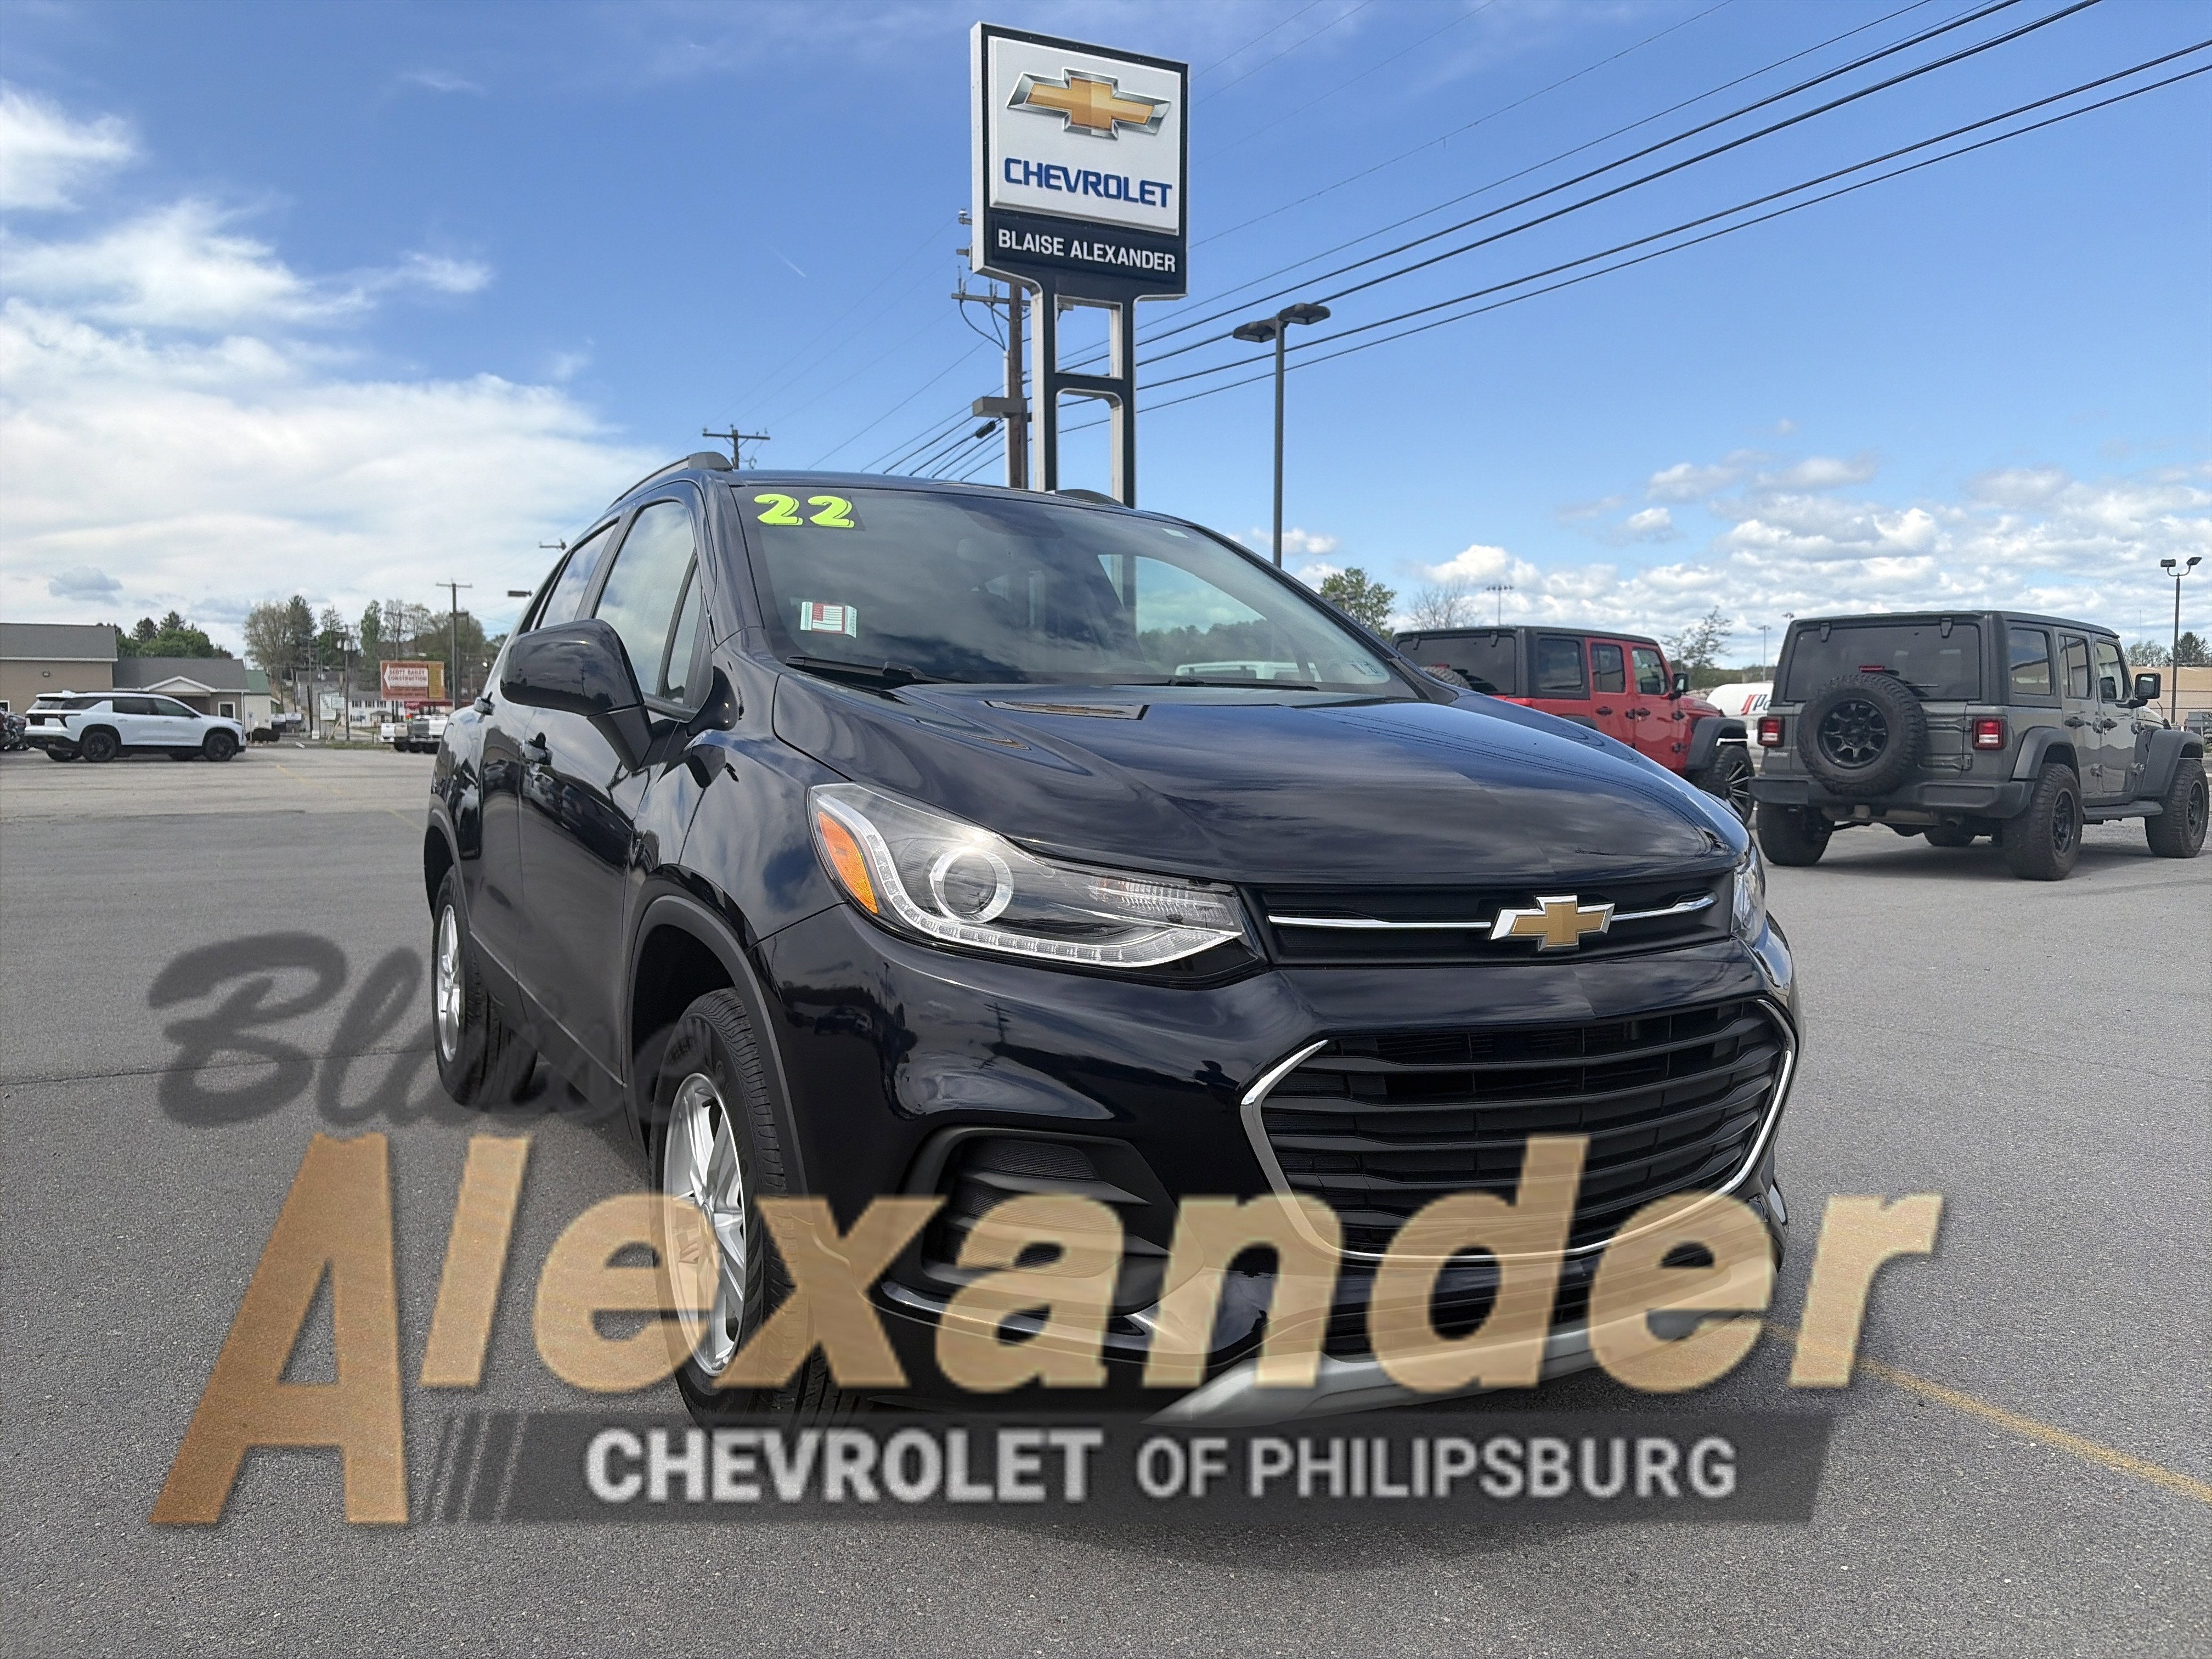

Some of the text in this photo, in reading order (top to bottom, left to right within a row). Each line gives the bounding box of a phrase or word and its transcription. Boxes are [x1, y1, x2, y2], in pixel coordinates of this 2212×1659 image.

[1004, 157, 1172, 208] CHEVROLET
[997, 228, 1176, 273] BLAISE ALEXANDER
[754, 493, 859, 529] 22
